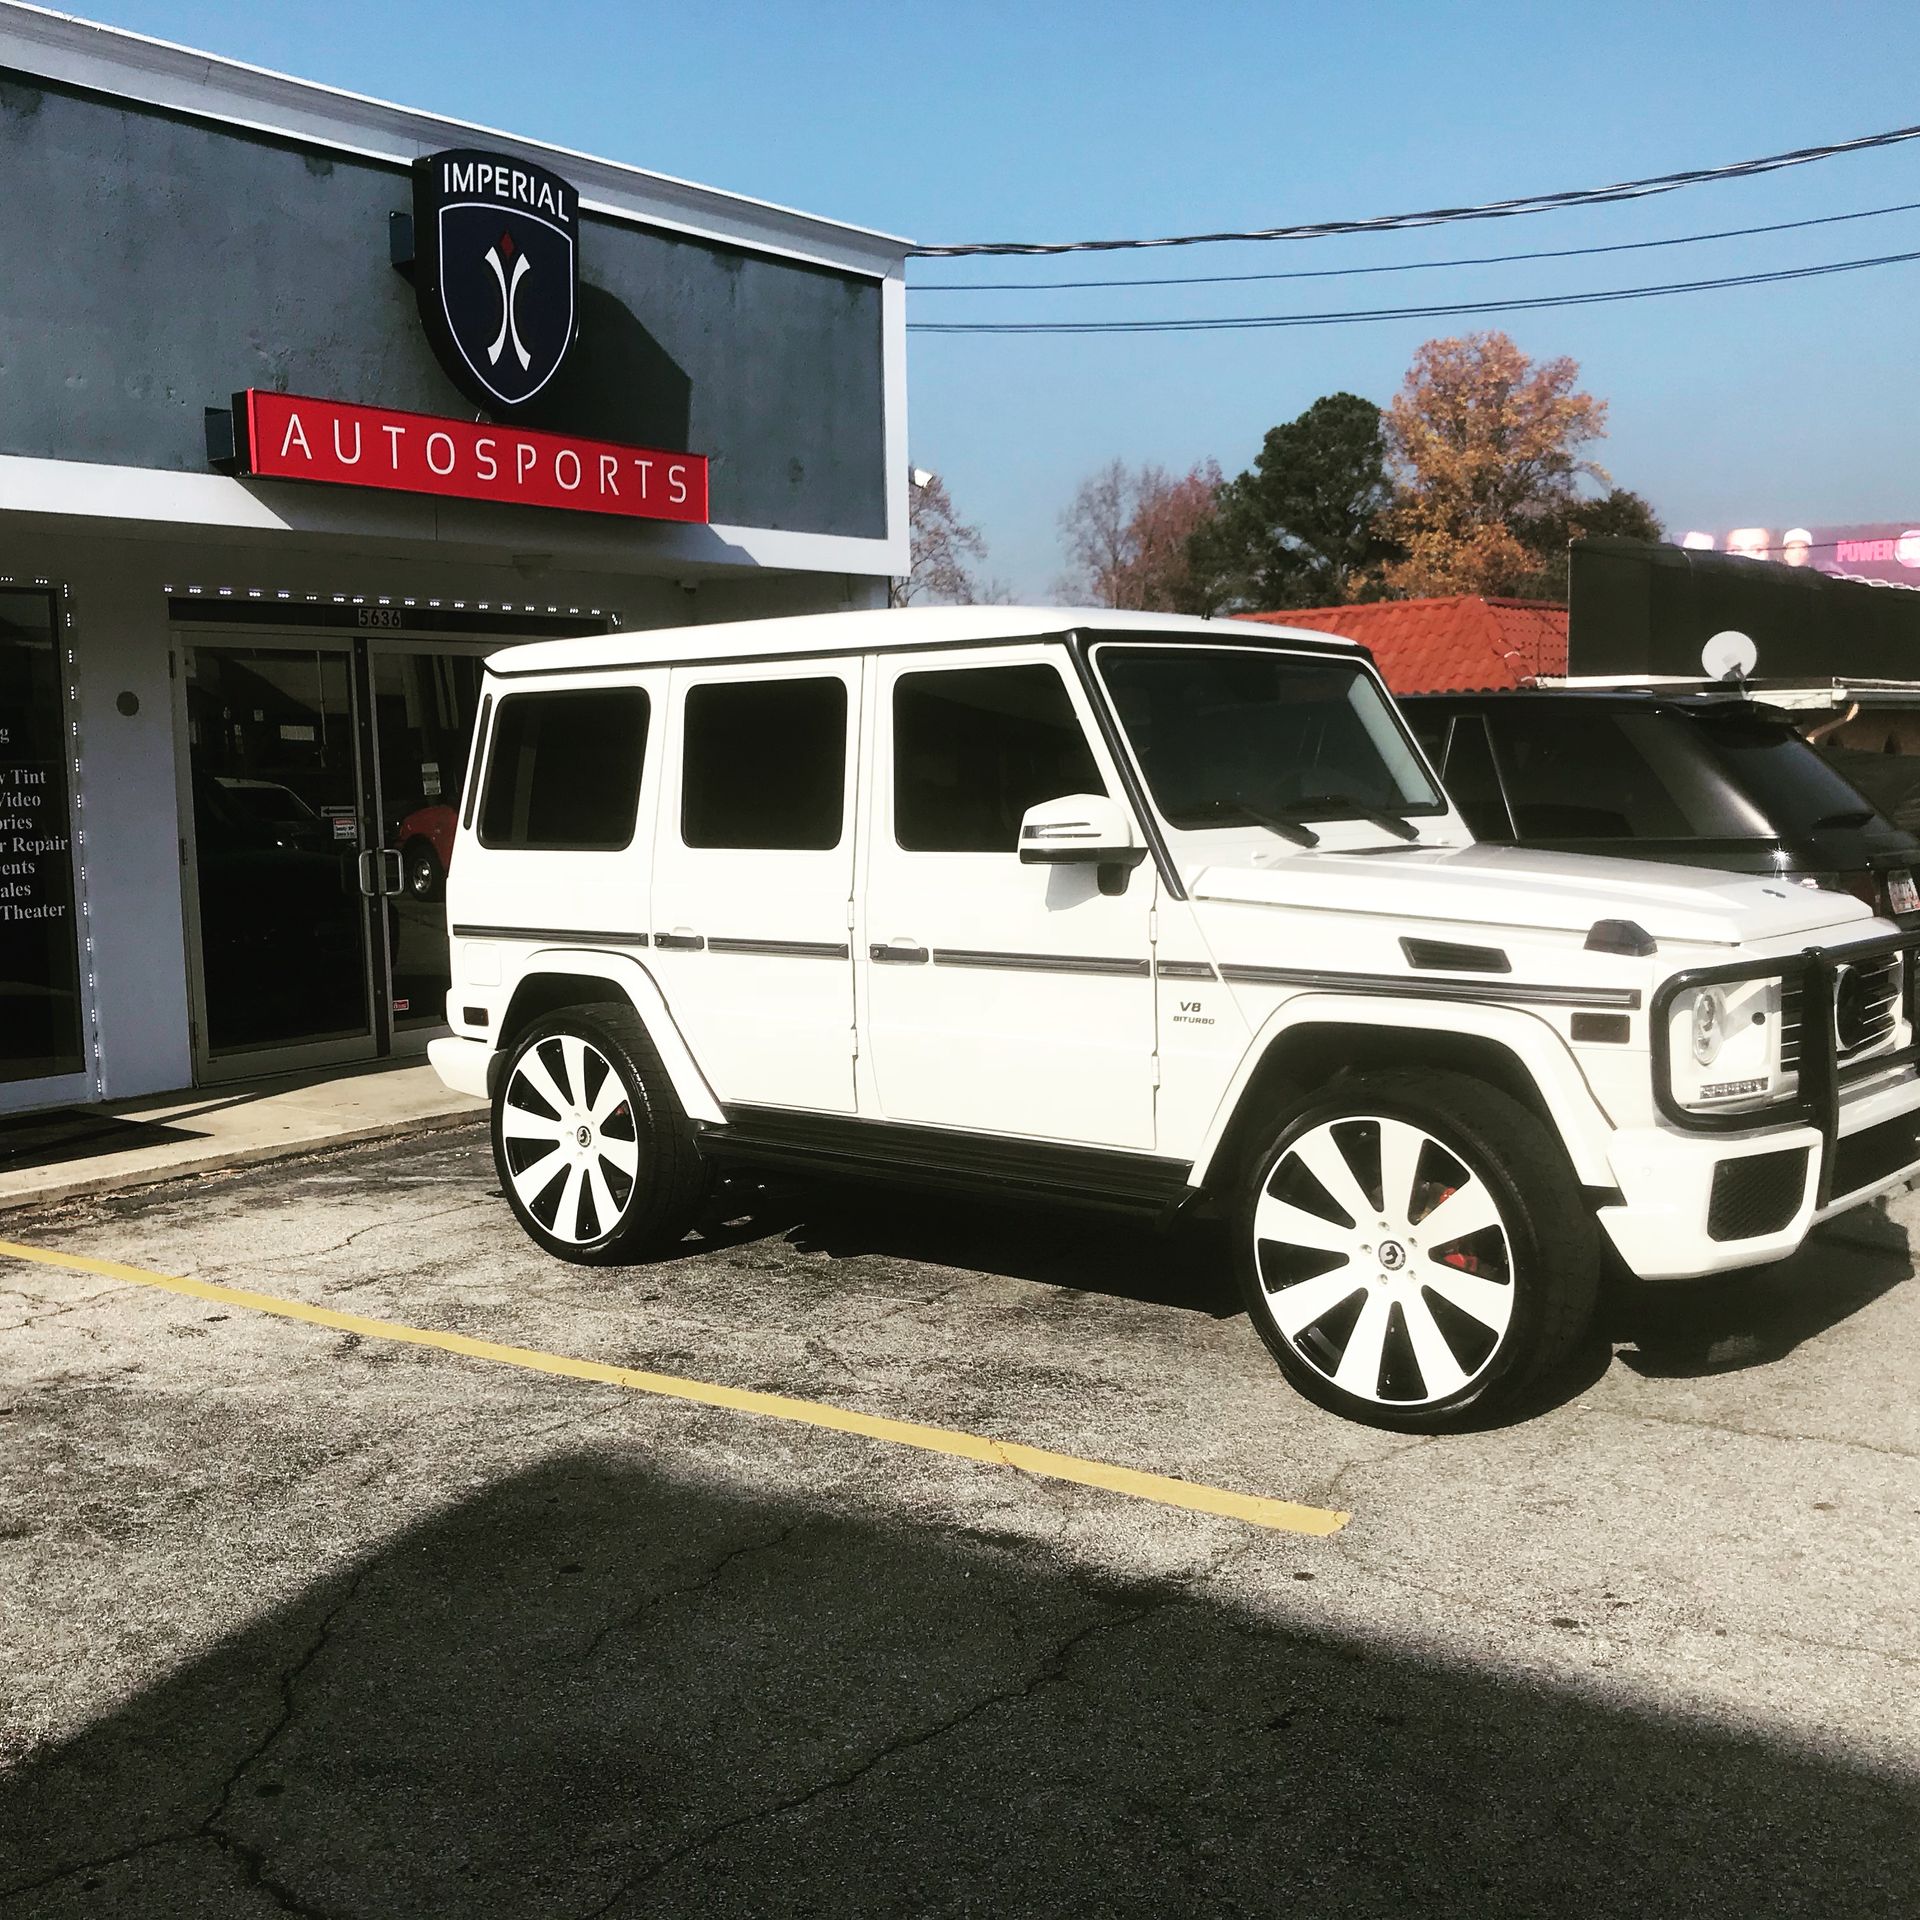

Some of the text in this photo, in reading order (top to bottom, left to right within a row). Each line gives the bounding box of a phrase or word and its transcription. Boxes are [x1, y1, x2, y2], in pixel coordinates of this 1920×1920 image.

[442, 162, 570, 223] IMPERIAL
[280, 413, 688, 504] AUTOSPORTS
[1837, 540, 1894, 562] POWER
[360, 610, 400, 626] 5636
[11, 769, 47, 784] Tint
[0, 814, 33, 830] ories
[12, 835, 68, 855] Repair
[0, 860, 35, 875] ents
[0, 882, 31, 898] ales
[0, 903, 65, 921] Theater
[1180, 1001, 1201, 1012] V8
[1173, 1015, 1215, 1024] BITURBO
